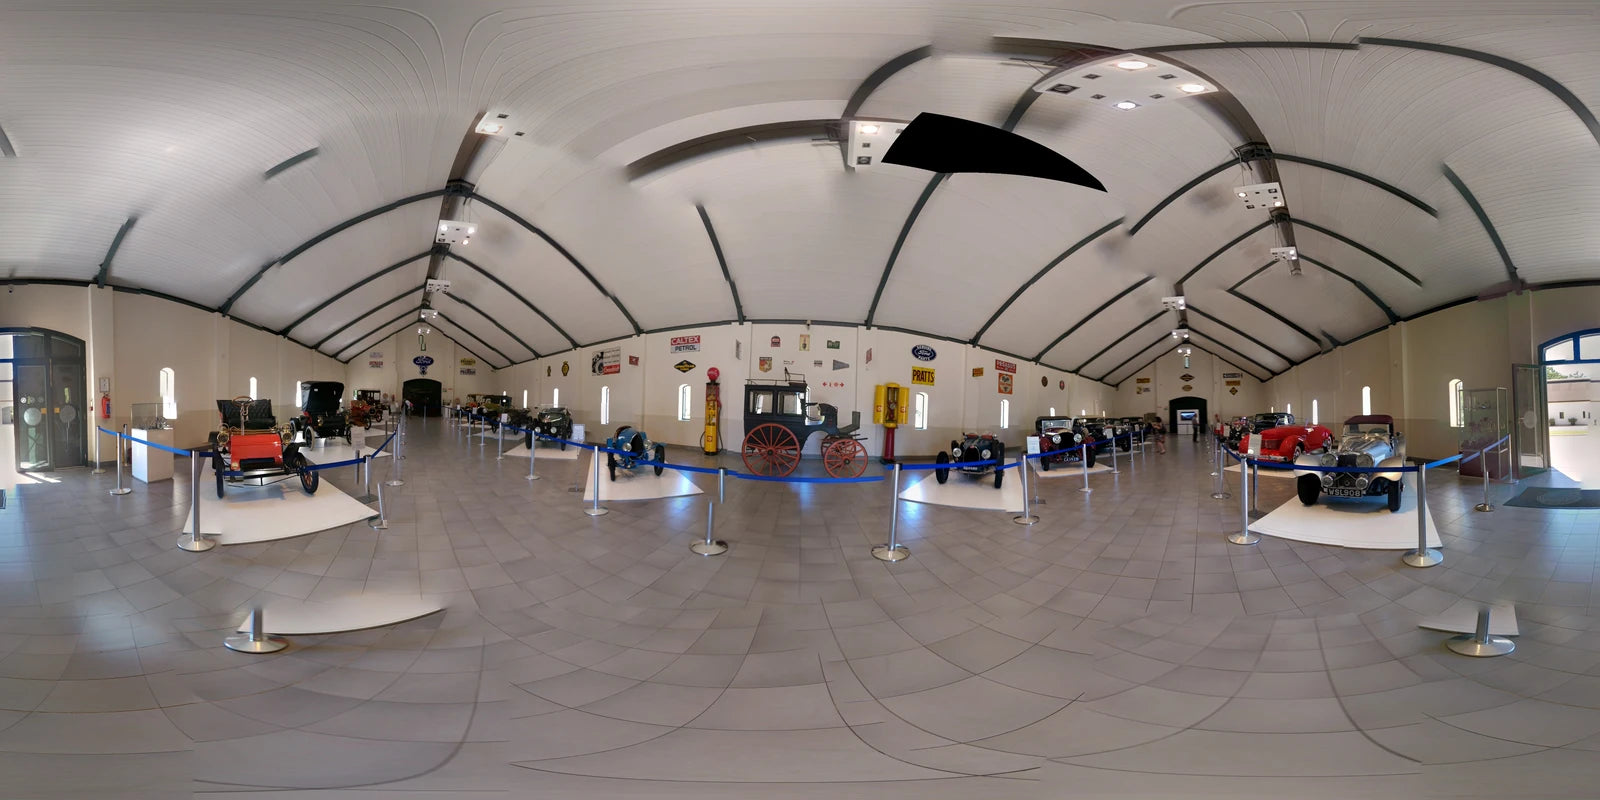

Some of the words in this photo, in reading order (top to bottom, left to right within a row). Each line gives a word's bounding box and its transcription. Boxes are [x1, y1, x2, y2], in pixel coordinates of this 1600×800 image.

[672, 335, 699, 345] CALTEX
[912, 369, 935, 383] PRATTS
[1328, 488, 1360, 497] WSL908
